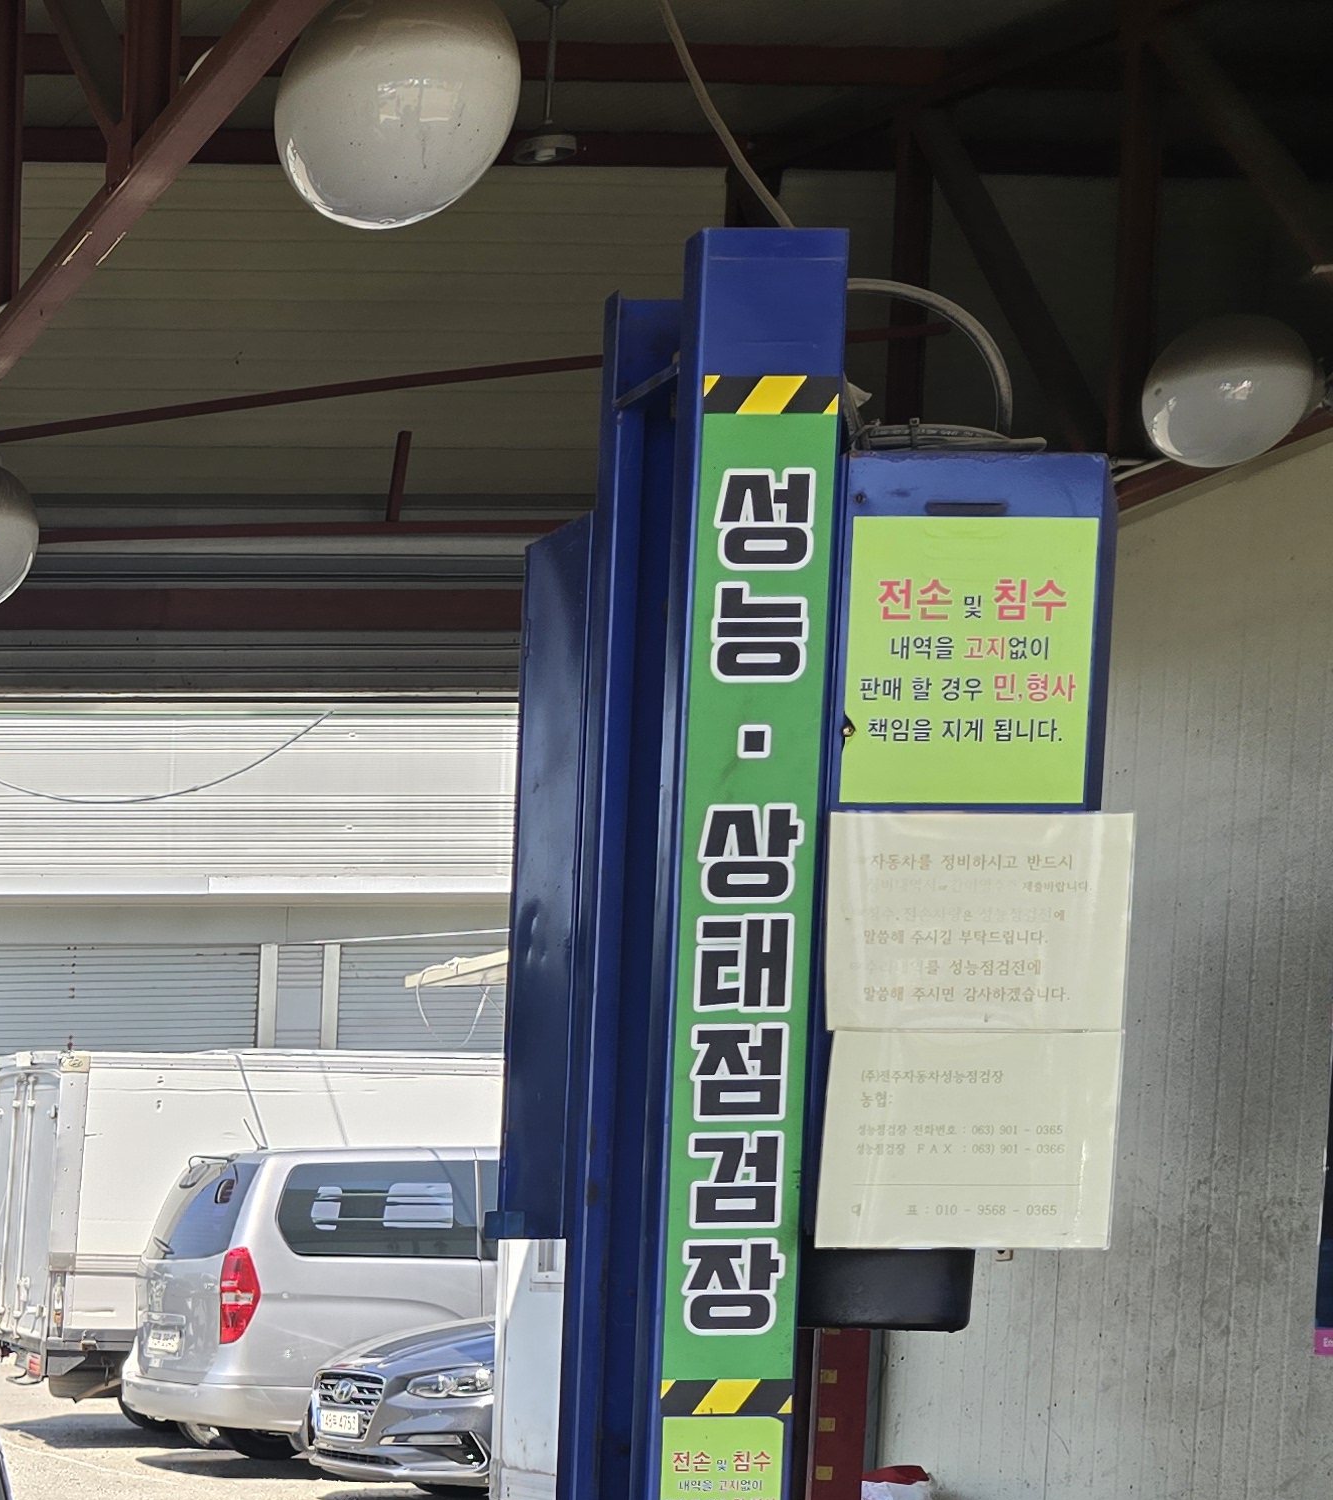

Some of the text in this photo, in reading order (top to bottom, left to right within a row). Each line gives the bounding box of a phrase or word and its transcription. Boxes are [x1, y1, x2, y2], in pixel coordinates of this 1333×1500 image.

[878, 578, 1067, 621] 전손 및 침수
[890, 636, 1050, 660] 내역을 고지없이
[860, 674, 1076, 702] 판매 할 경우 민,형사
[868, 718, 1063, 742] 책임을 지게 됩니다.
[870, 854, 1074, 871] 자동차를 정비하시고 반드시
[864, 929, 1048, 945] 말씀해 주시길 부탁드립니다.
[949, 959, 1042, 976] 성능점검전에
[864, 986, 904, 1002] 말씀해
[963, 986, 1070, 1002] 감사하겠습니다.
[913, 1124, 957, 1136] 전화번호
[935, 1205, 958, 1216] 010
[673, 1451, 771, 1472] 전손 및 침수
